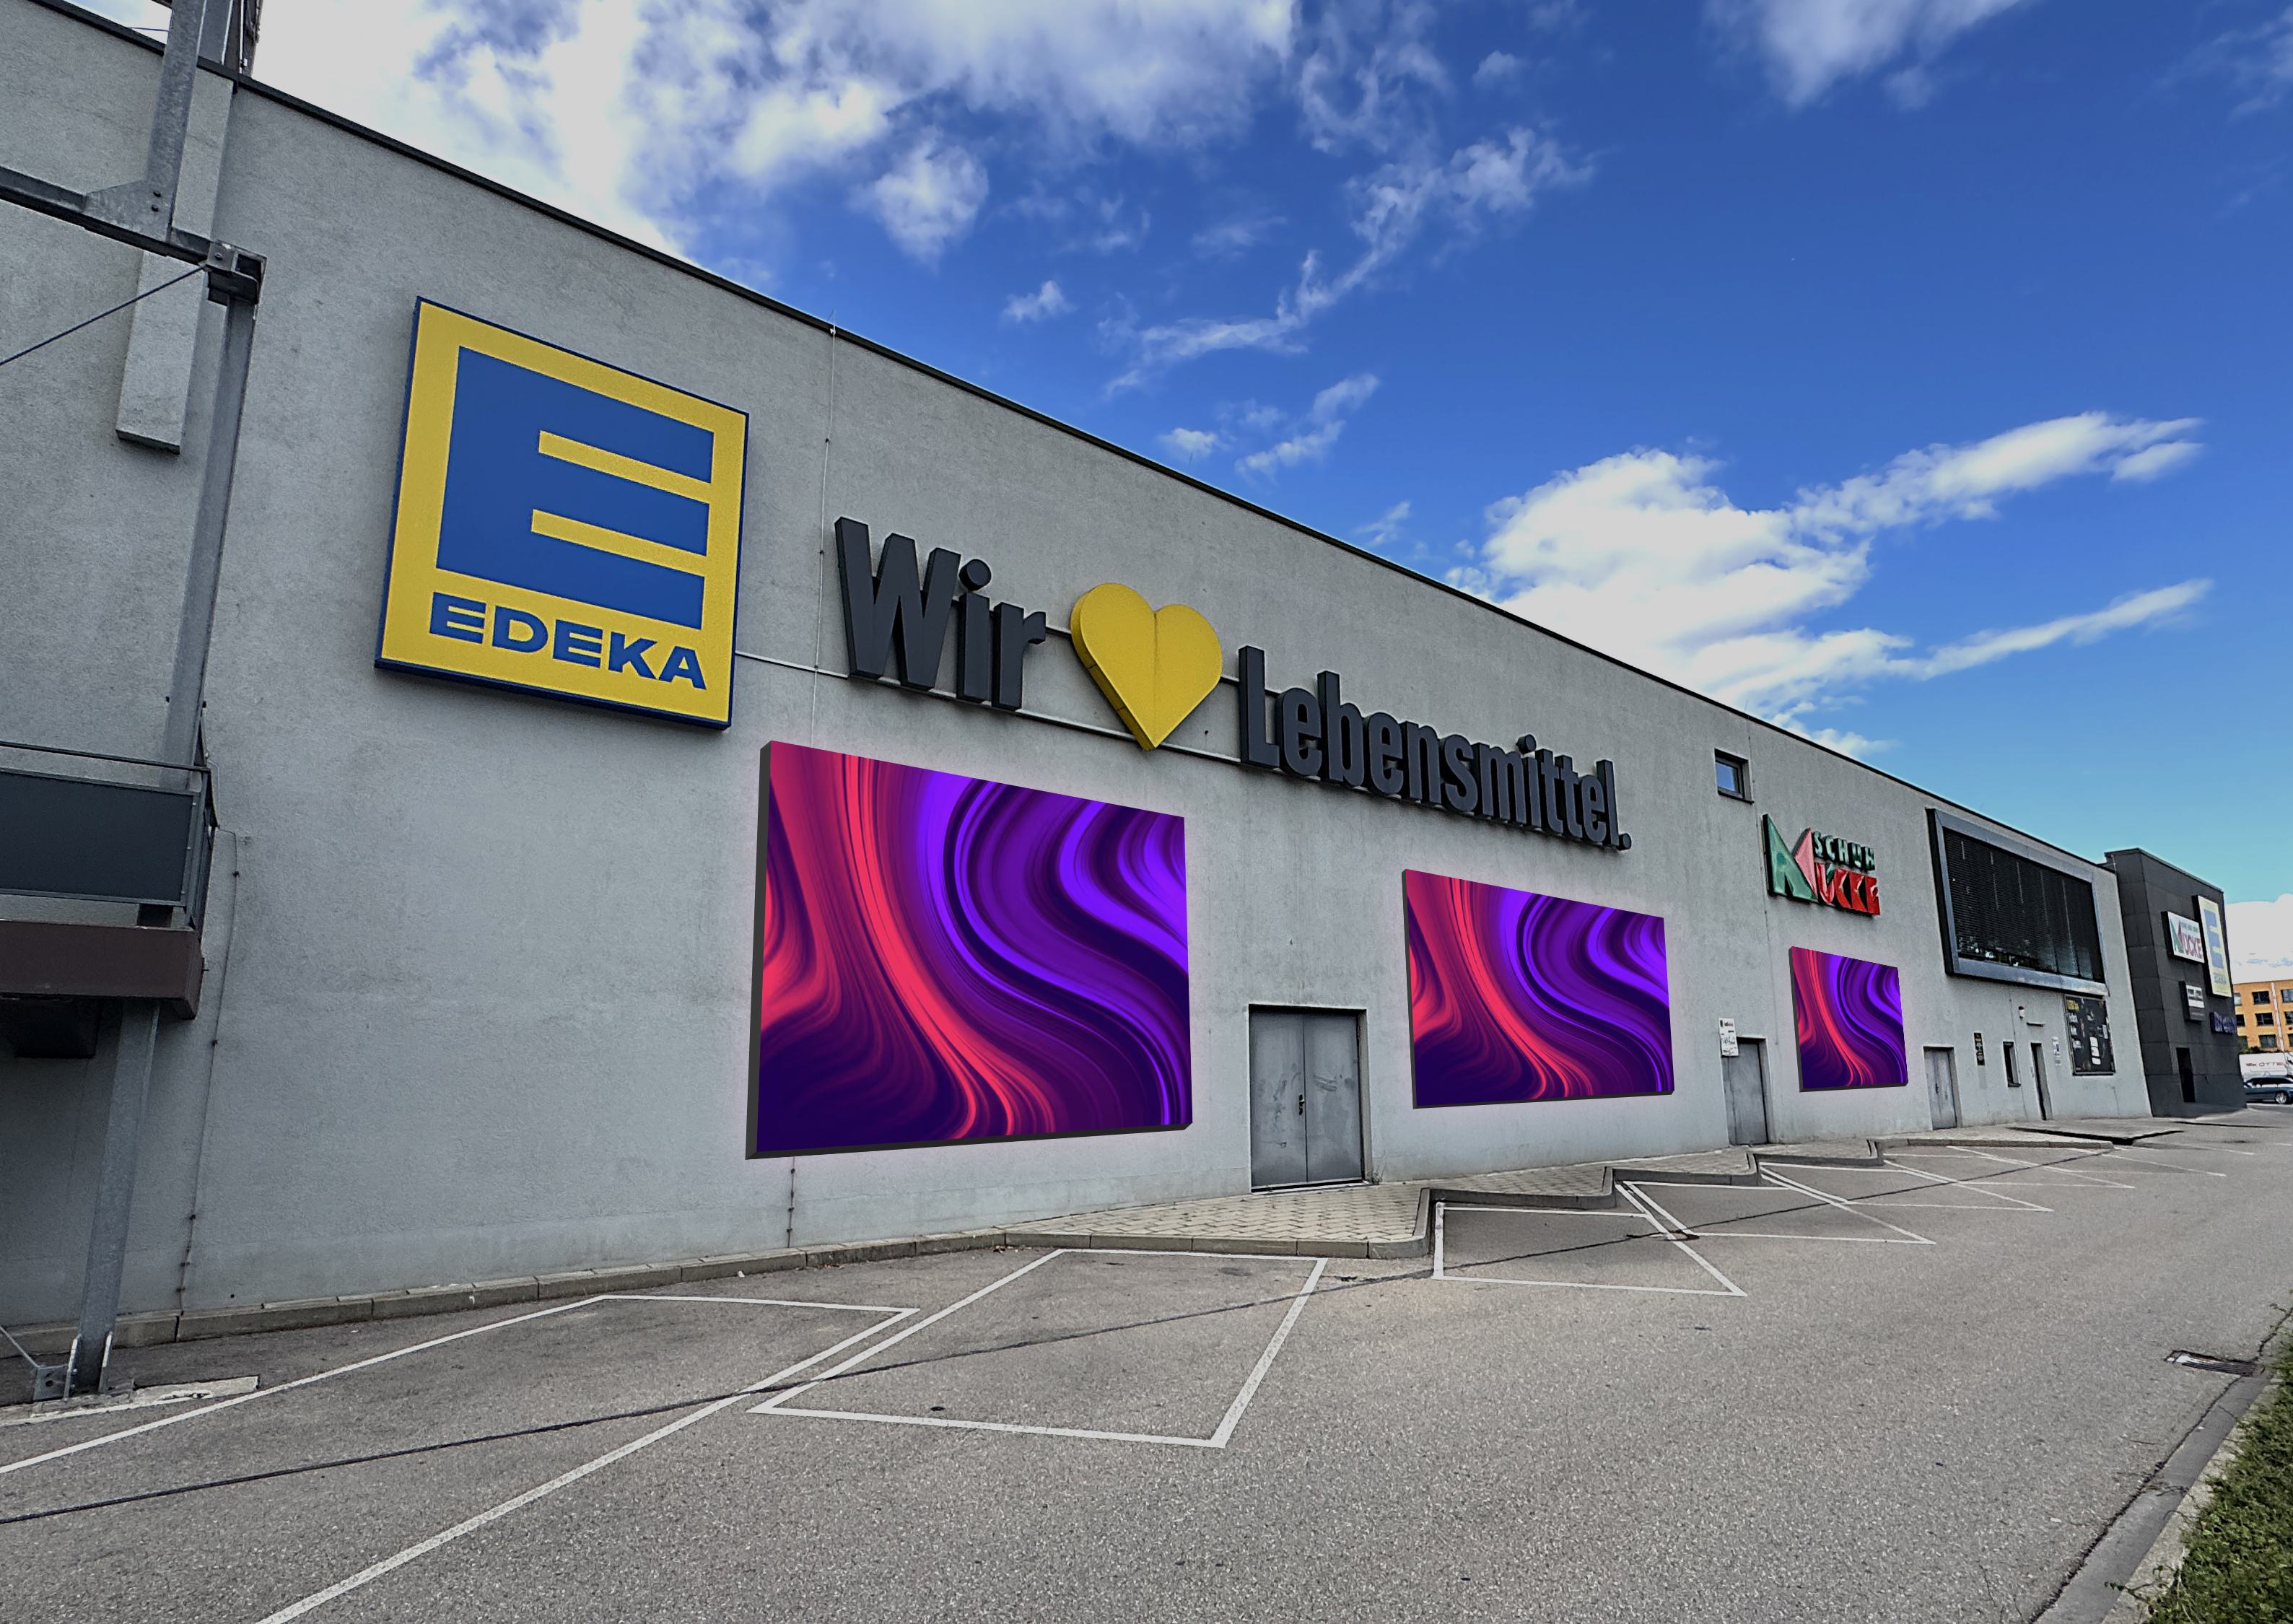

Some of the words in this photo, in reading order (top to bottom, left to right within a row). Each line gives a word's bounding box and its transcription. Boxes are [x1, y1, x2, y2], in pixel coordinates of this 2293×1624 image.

[429, 591, 707, 690] EDEKA
[835, 516, 1047, 710] Wir
[1239, 645, 1631, 850] Lebensmittel.
